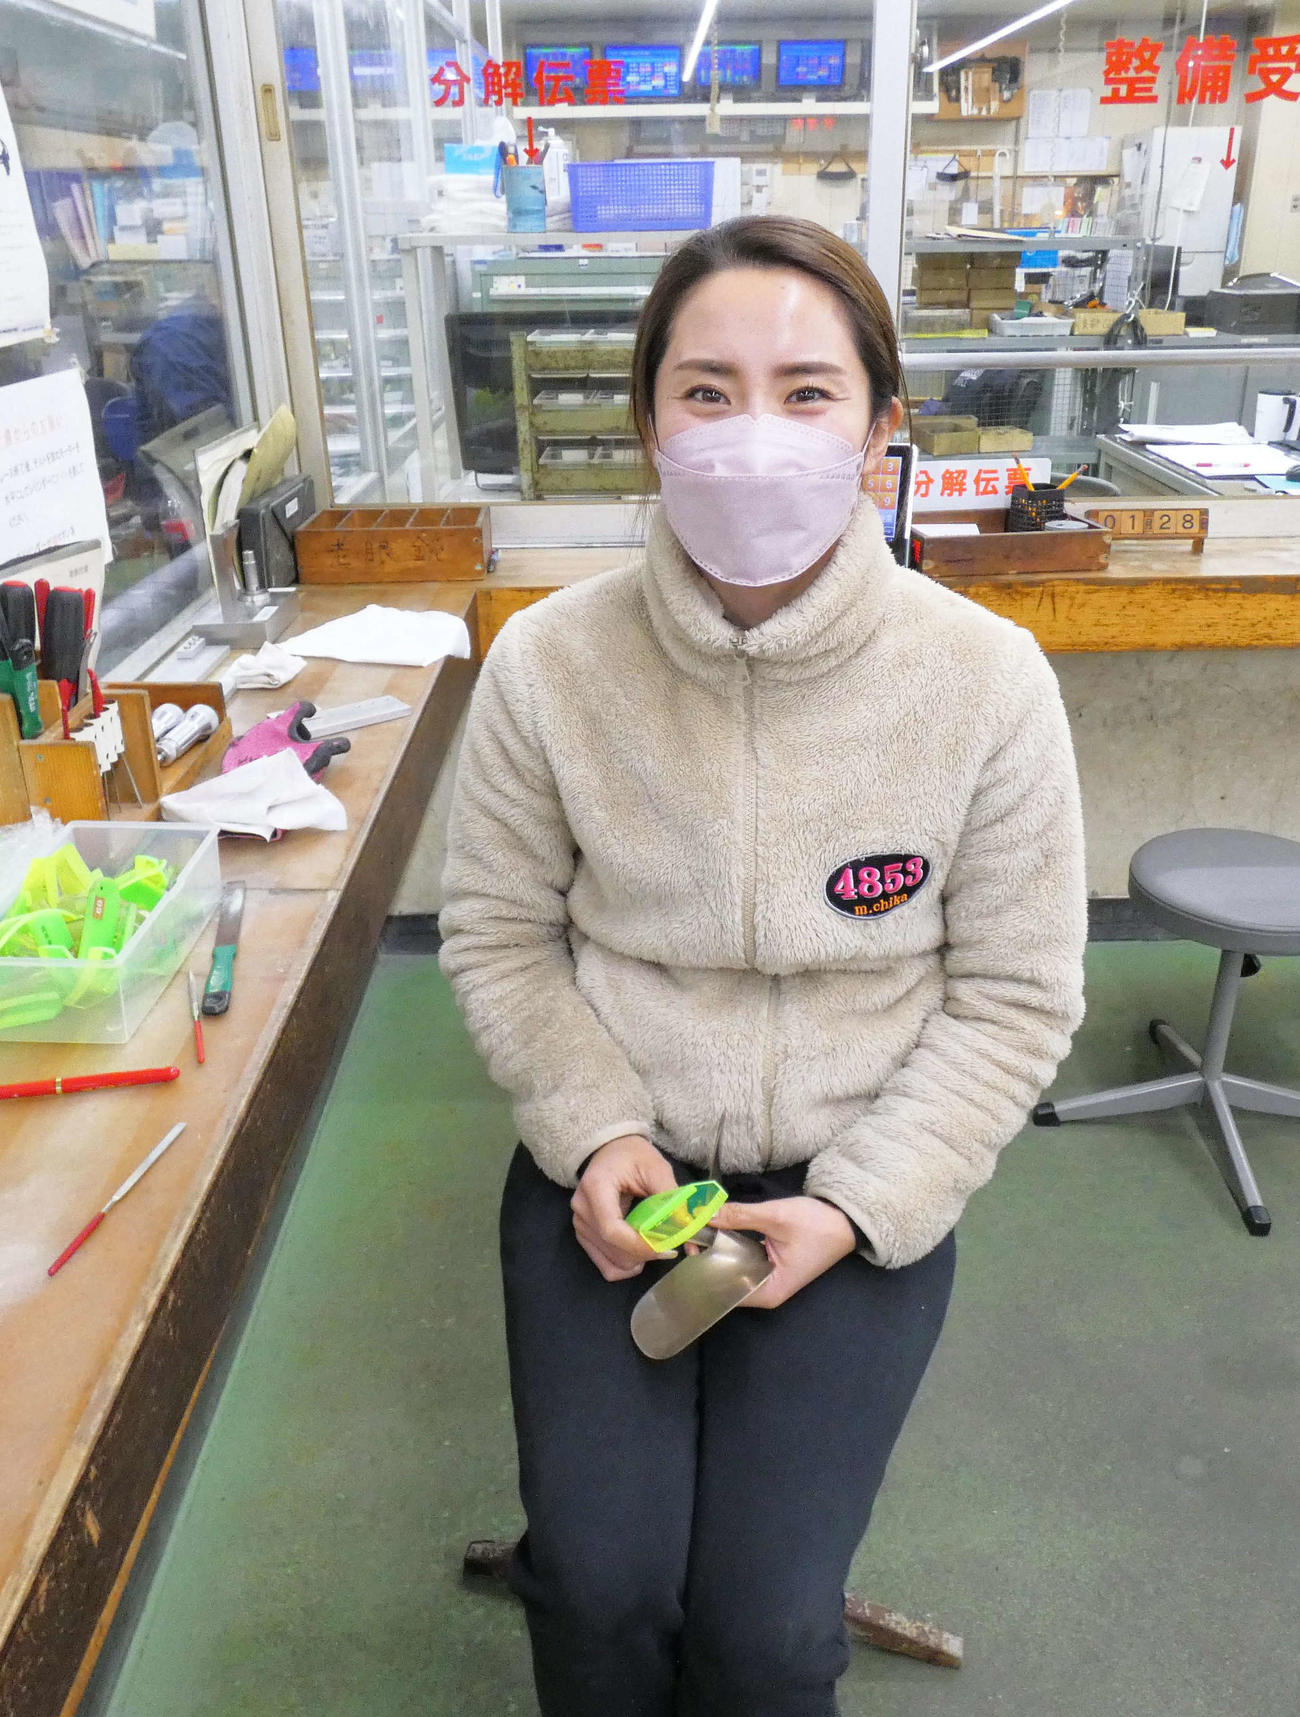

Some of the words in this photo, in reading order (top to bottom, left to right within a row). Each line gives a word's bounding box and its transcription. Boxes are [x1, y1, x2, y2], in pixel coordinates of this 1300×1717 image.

[1100, 34, 1300, 104] 整備受
[430, 59, 626, 106] 分解伝票
[886, 462, 894, 472] 3
[885, 481, 893, 489] 6
[884, 496, 891, 506] 9
[834, 857, 924, 900] 4853
[854, 893, 908, 915] m.chika
